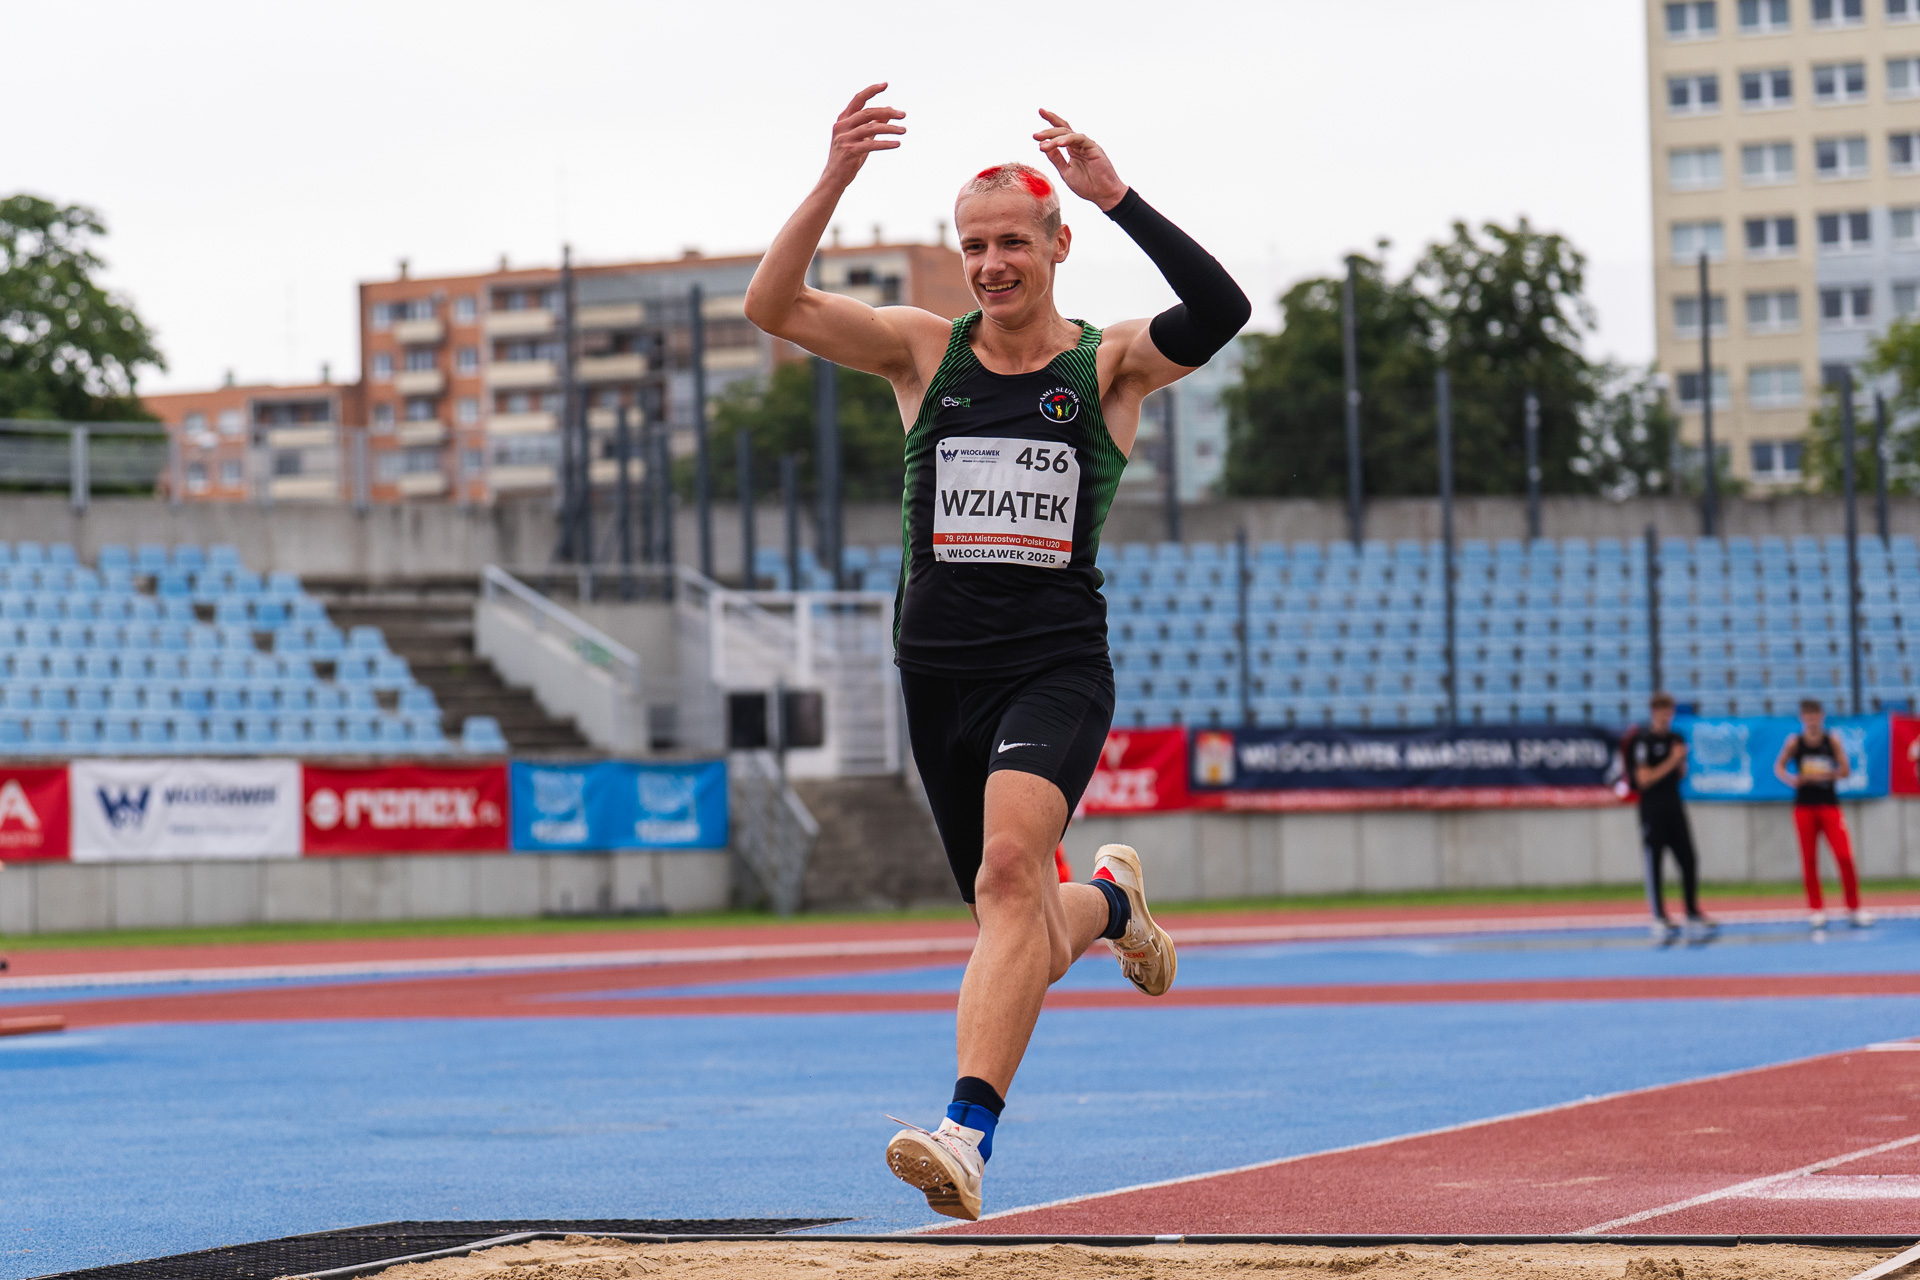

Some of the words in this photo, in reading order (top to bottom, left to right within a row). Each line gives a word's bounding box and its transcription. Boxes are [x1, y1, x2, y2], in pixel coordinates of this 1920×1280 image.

[960, 449, 1000, 457] WŁOCŁAWEK
[1016, 447, 1069, 474] 456
[941, 489, 1070, 523] WZIĄTEK
[975, 535, 1021, 544] Mistrzostwa
[1023, 538, 1044, 546] Polski
[1046, 541, 1061, 549] U20
[947, 549, 1025, 560] WŁOCŁAWEK
[1027, 551, 1056, 564] 2025
